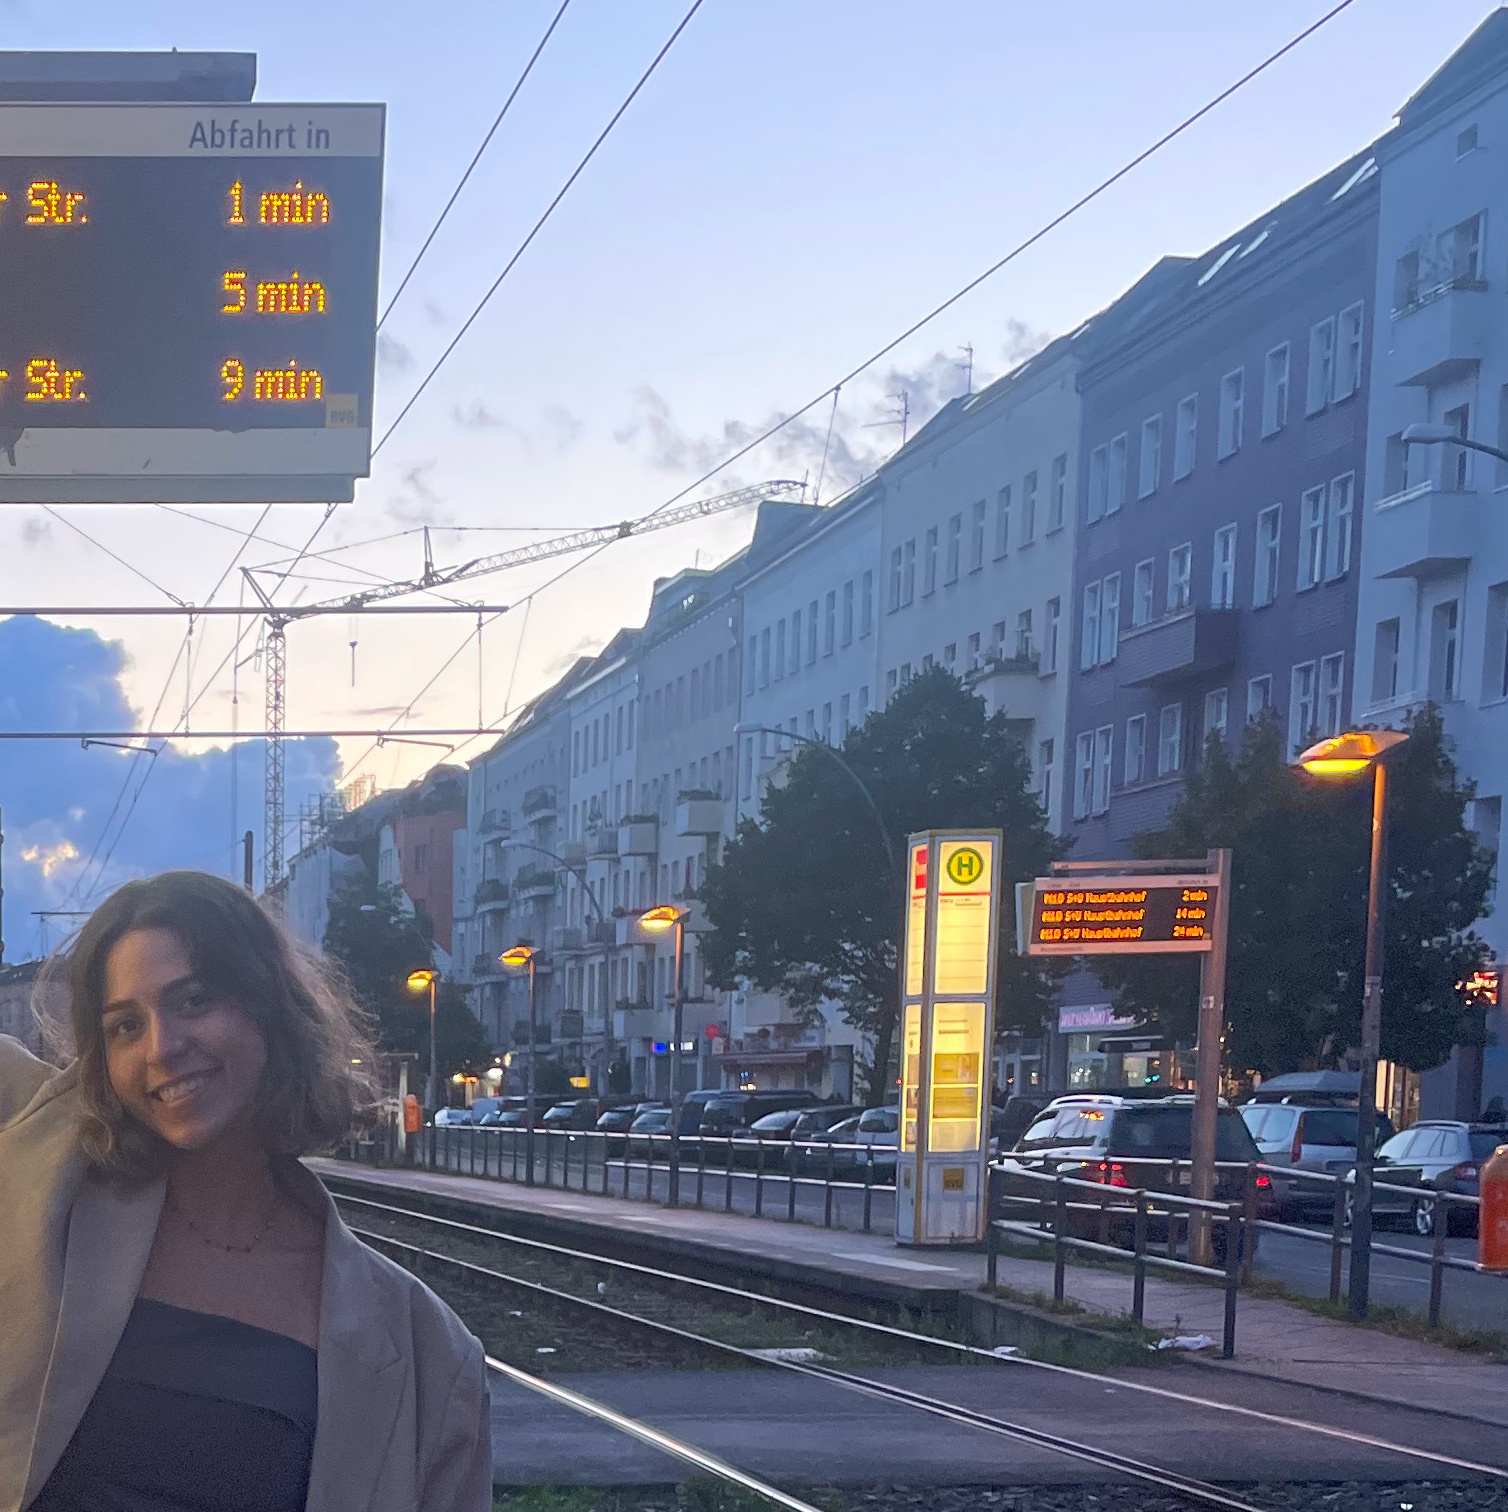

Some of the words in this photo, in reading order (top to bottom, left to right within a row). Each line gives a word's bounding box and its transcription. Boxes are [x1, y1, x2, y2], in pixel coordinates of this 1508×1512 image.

[189, 119, 296, 150] Abfahrt
[307, 119, 331, 150] in
[27, 181, 88, 224] Str.
[228, 181, 244, 224] 1
[260, 181, 331, 224] min
[222, 270, 247, 313] 5
[256, 270, 327, 313] min
[26, 358, 88, 401] Str.
[221, 358, 244, 401] 9
[255, 358, 324, 401] min
